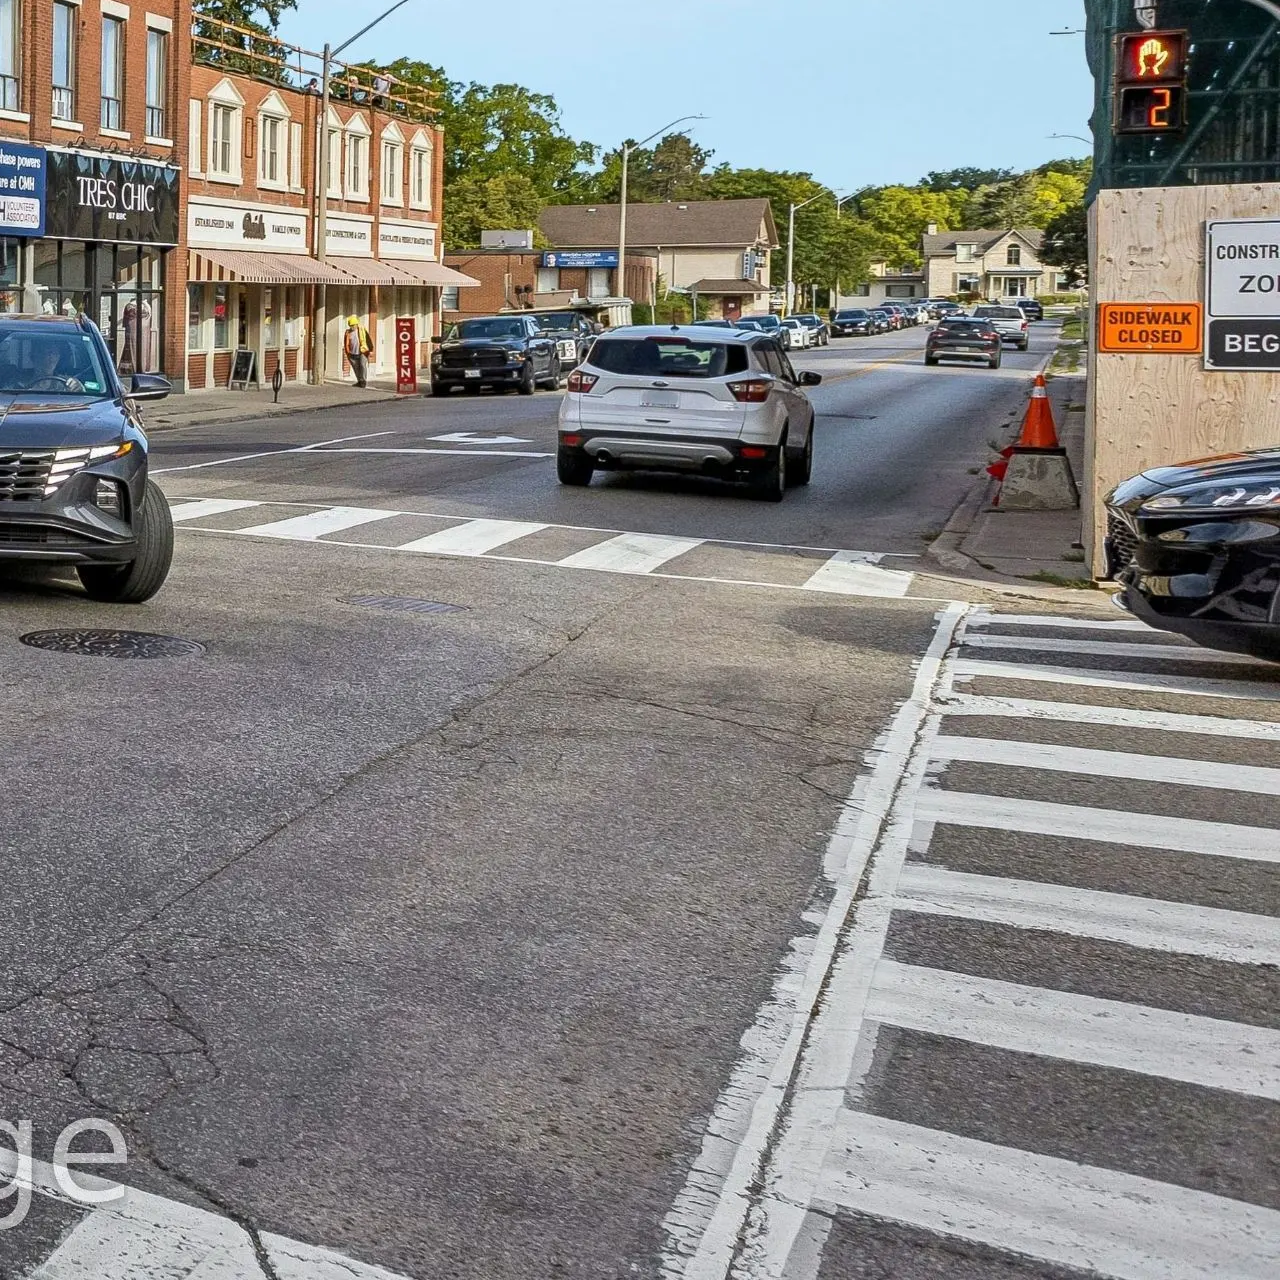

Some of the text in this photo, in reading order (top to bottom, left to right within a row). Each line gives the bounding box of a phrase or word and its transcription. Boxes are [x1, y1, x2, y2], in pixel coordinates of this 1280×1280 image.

[1150, 88, 1171, 126] 2
[17, 155, 41, 171] powers
[9, 176, 17, 189] at
[18, 175, 35, 191] CMH
[76, 172, 155, 212] TRÈS CHIC
[6, 201, 35, 212] VOLUNTEER
[6, 212, 39, 223] ASSOCIATION
[1107, 310, 1193, 326] SIDEWALK
[1117, 329, 1183, 344] CLOSED
[399, 331, 411, 378] OPEN
